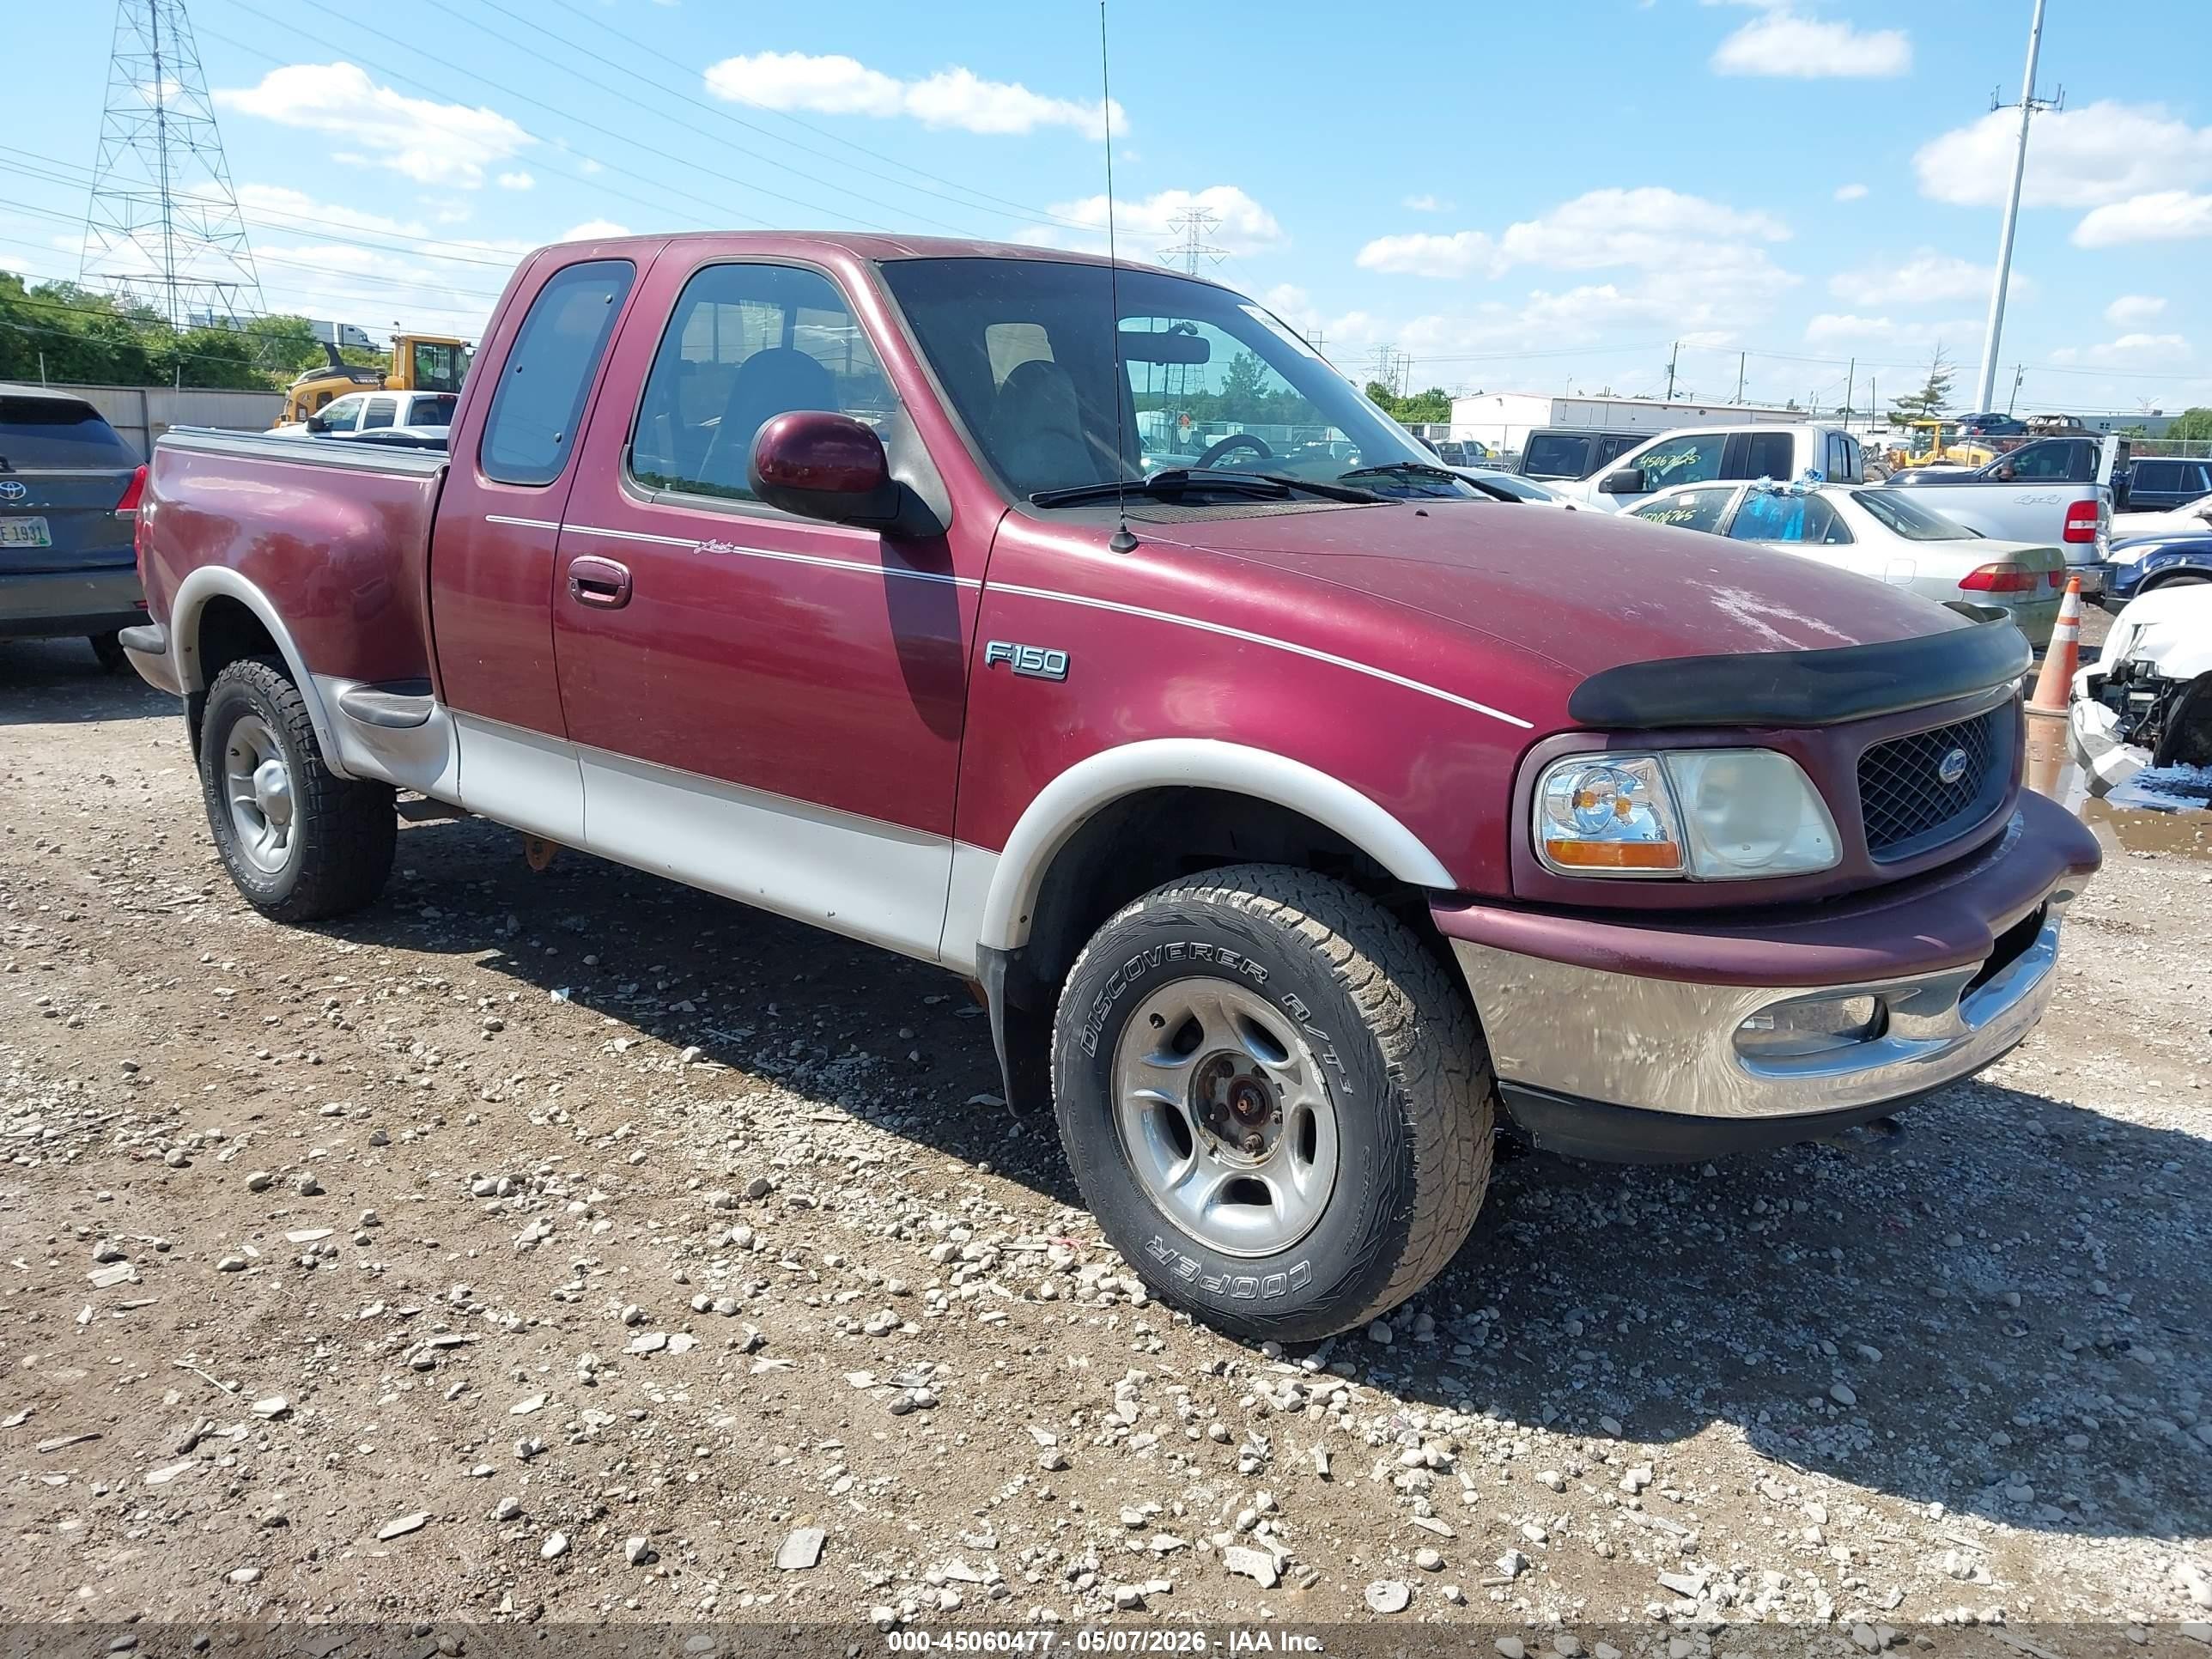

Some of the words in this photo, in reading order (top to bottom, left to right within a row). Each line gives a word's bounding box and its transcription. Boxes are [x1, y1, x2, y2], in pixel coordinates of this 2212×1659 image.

[12, 525, 46, 541] 1931
[1079, 941, 1270, 1059] DISCOVERER
[1145, 1235, 1312, 1300] COOPER
